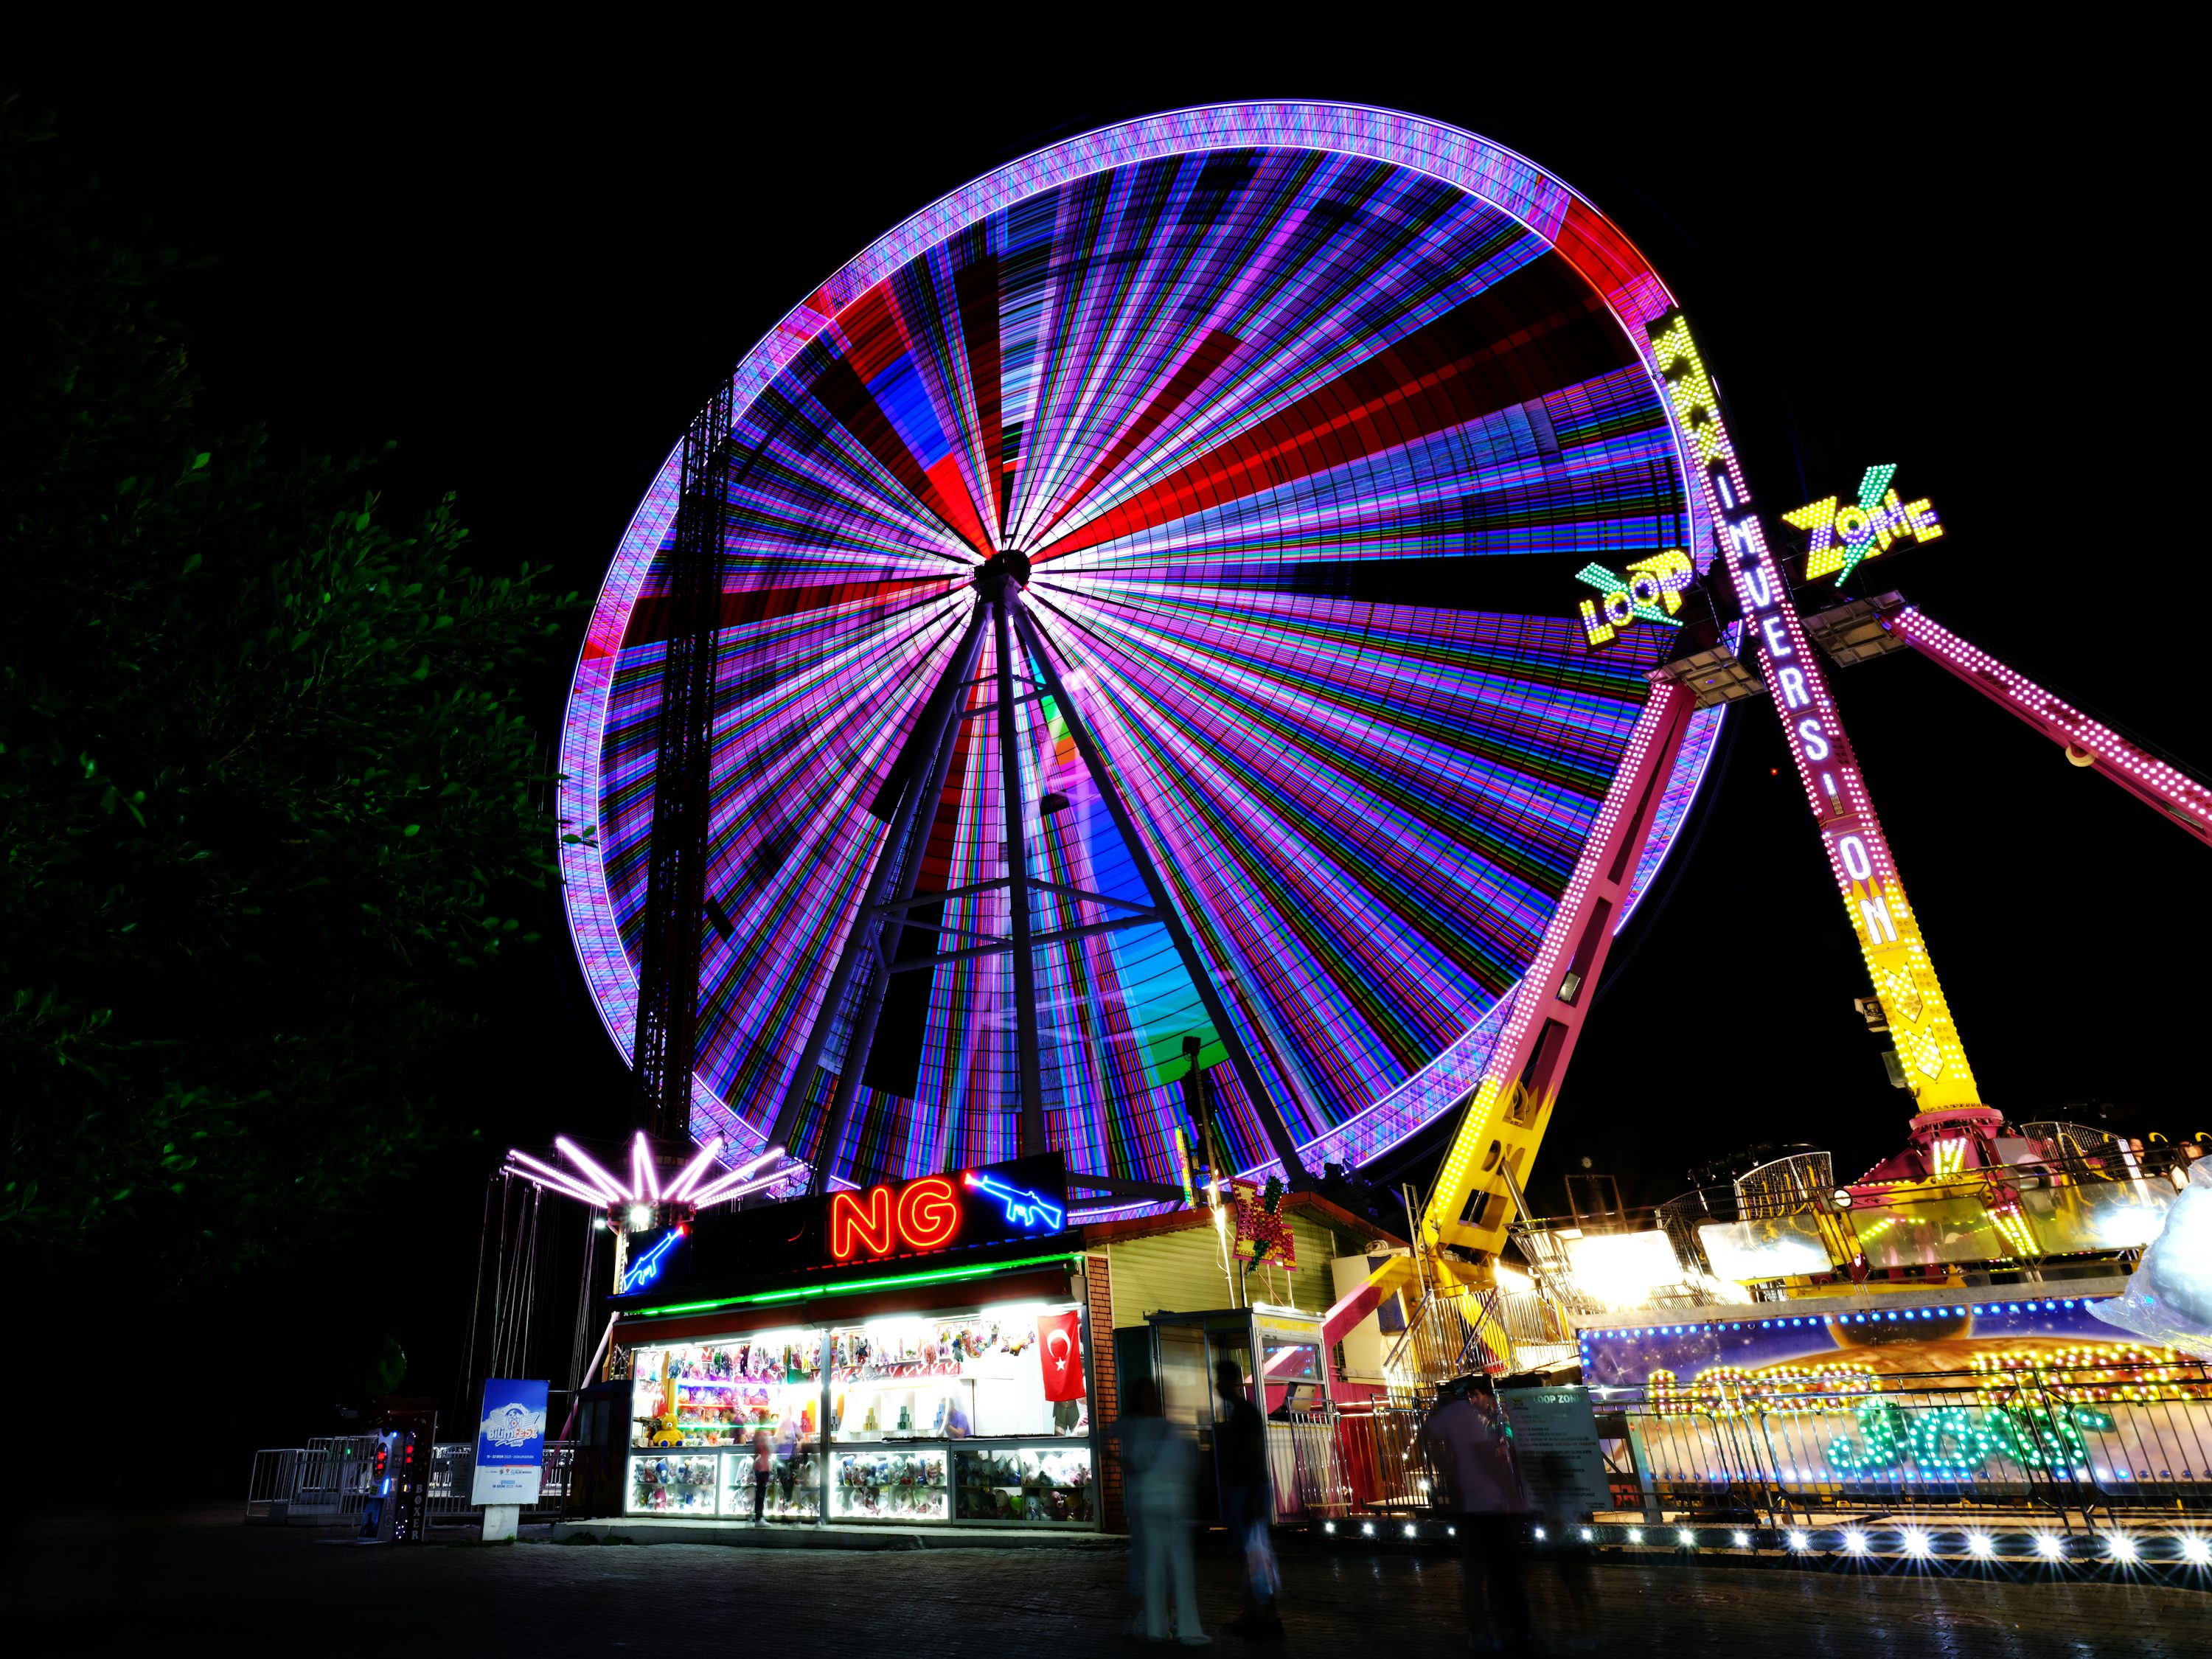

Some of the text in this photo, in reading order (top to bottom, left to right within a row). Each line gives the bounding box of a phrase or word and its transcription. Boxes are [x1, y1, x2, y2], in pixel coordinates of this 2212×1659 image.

[1781, 488, 1944, 582] ZONE
[1579, 549, 1694, 647] LOOP
[411, 1483, 424, 1541] BOXER
